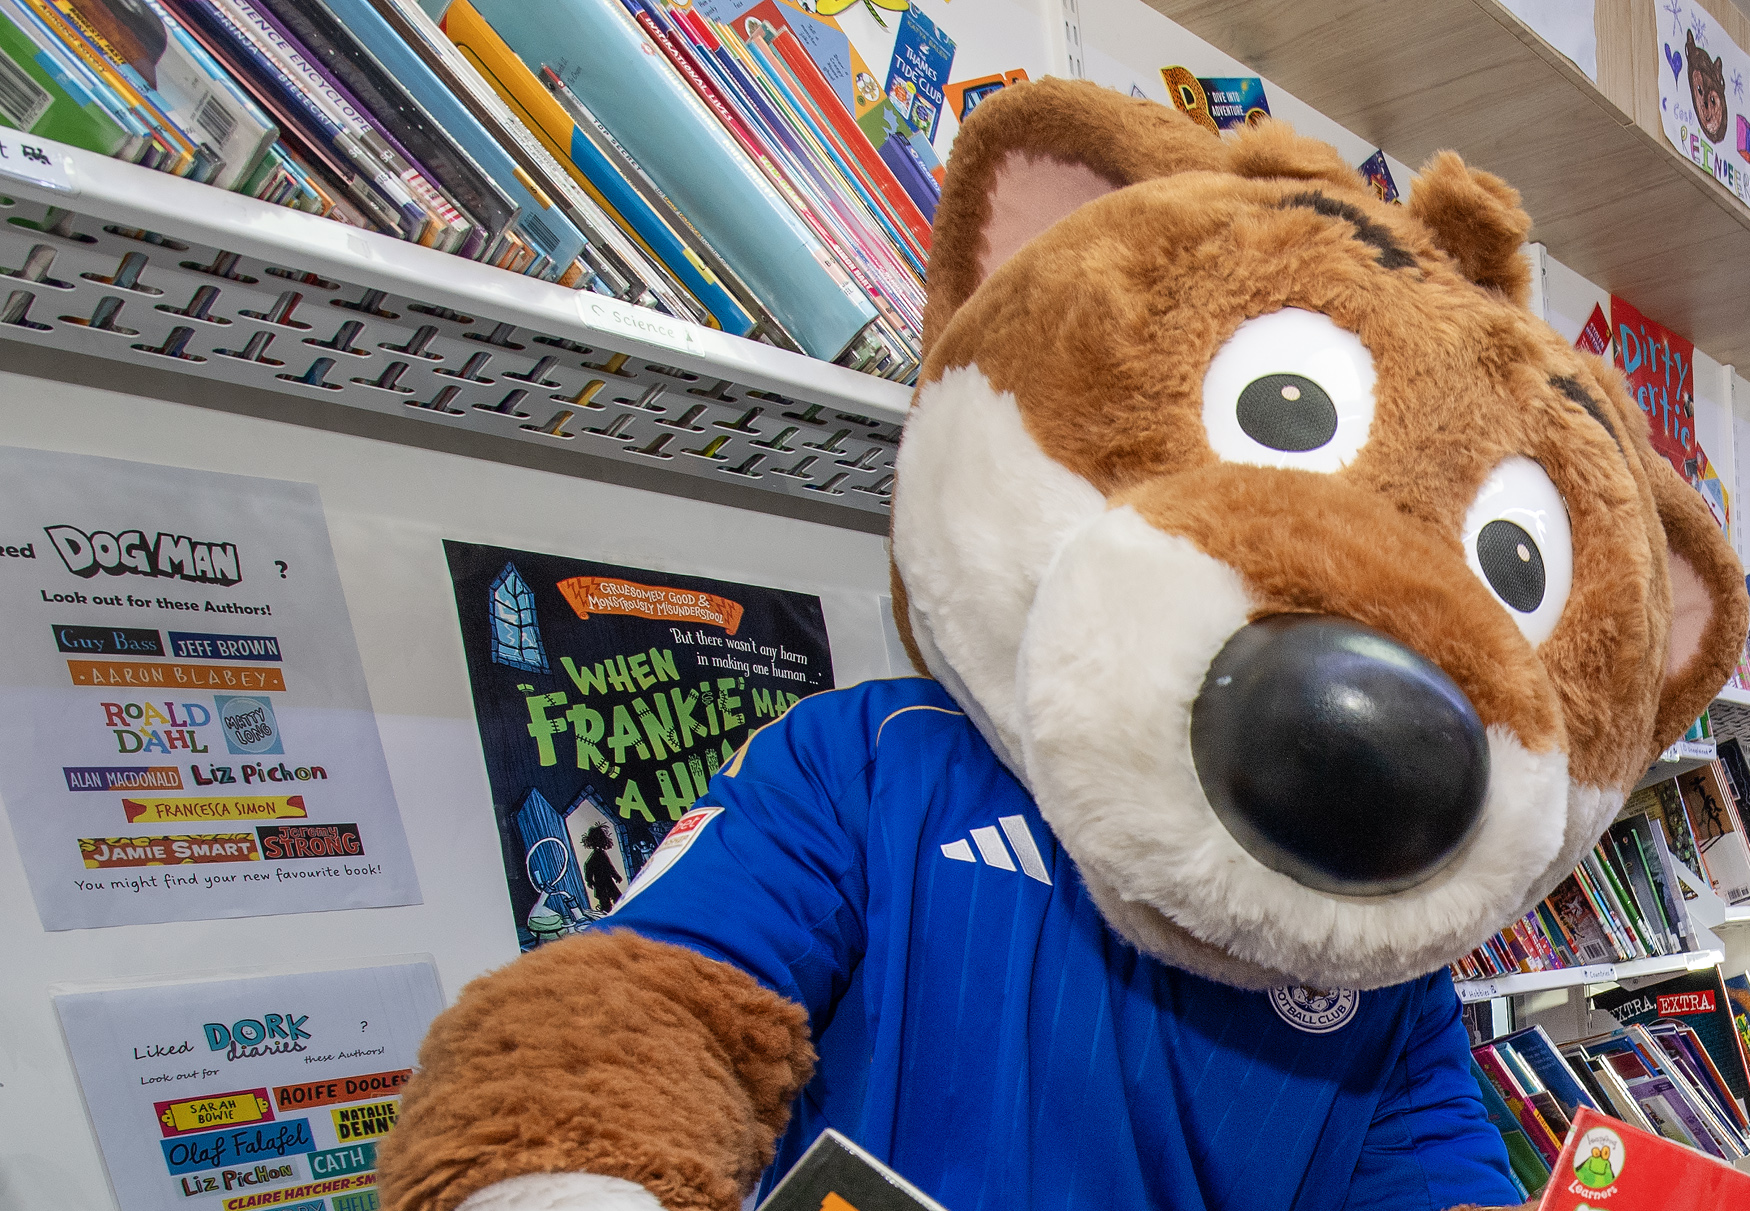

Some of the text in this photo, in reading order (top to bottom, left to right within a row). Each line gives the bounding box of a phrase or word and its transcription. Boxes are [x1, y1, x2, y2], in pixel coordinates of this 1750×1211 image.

[213, 10, 259, 57] PRINJA
[919, 78, 942, 104] CLUB
[613, 309, 676, 340] Science
[1619, 323, 1688, 401] Dirty
[41, 589, 273, 616] Look out for these Authors!
[588, 595, 654, 616] MONSTROUSLY
[600, 582, 710, 608] GRUESOMELY GOOD &
[59, 629, 158, 655] Guy Bass
[178, 639, 279, 658] JEFF BROWN
[696, 630, 723, 647] there
[760, 645, 777, 662] any
[781, 644, 808, 665] harm
[92, 667, 267, 688] AARON BLABEY
[560, 647, 680, 696] WHEN
[697, 652, 806, 683] in making one human
[224, 707, 266, 730] MATTY
[113, 729, 209, 754] DAHL
[235, 722, 273, 746] LONG
[70, 770, 179, 789] ALAN MACDONALD
[190, 762, 328, 787] Liz Pichon
[155, 801, 277, 819] FRANCESCA SIMON
[616, 779, 656, 822] A
[278, 826, 338, 839] Jeremy
[93, 840, 250, 862] JAMIE SMART
[264, 833, 361, 858] STRONG
[74, 863, 382, 893] You might find your new favourite book!
[1318, 1004, 1346, 1025] CLUB
[1660, 993, 1716, 1015] EXTRA,
[134, 1013, 312, 1061] Liked DORK
[226, 1041, 307, 1062] diaries
[190, 1100, 237, 1112] SARAH
[198, 1111, 234, 1124] BOWIE
[169, 1123, 308, 1166] Olaf Falafel
[1568, 1179, 1618, 1200] Learners
